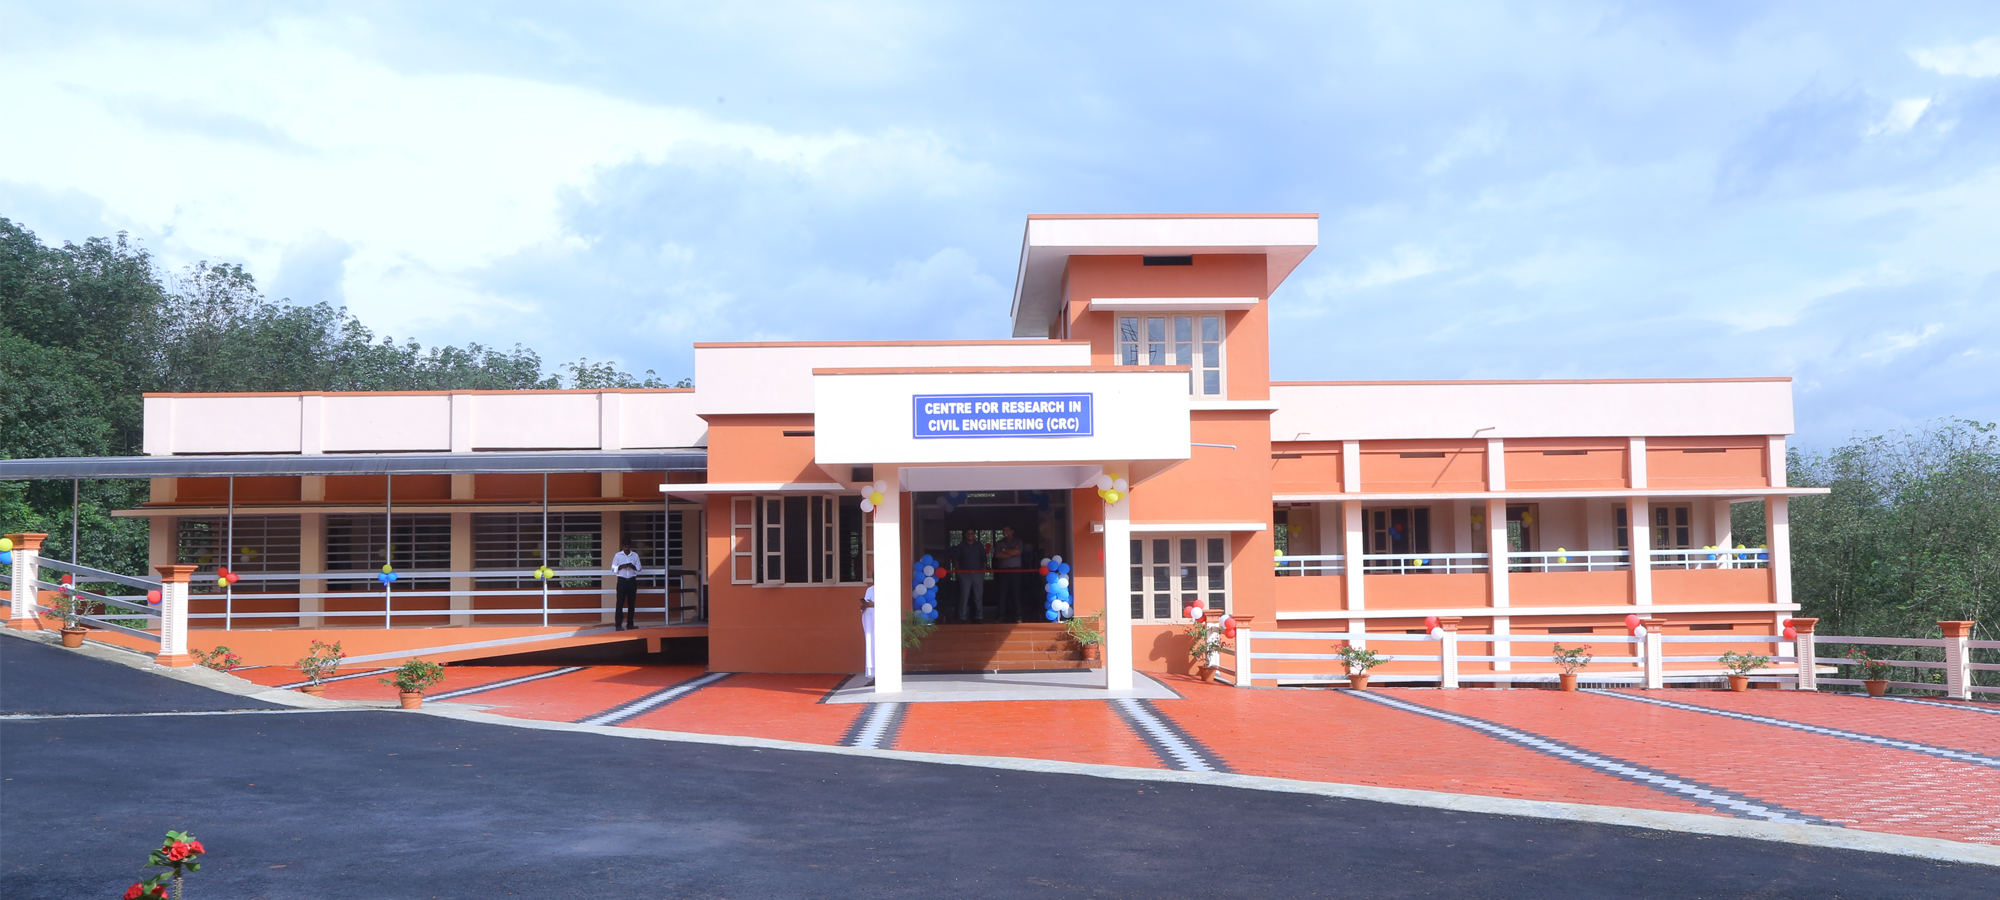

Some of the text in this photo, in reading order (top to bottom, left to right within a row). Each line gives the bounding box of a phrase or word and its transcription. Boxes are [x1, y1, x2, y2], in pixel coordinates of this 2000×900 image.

[925, 401, 1081, 415] CENTRE FOR RESEARCH IN
[928, 417, 1079, 432] CIVIL ENGINEERING (CRC)
